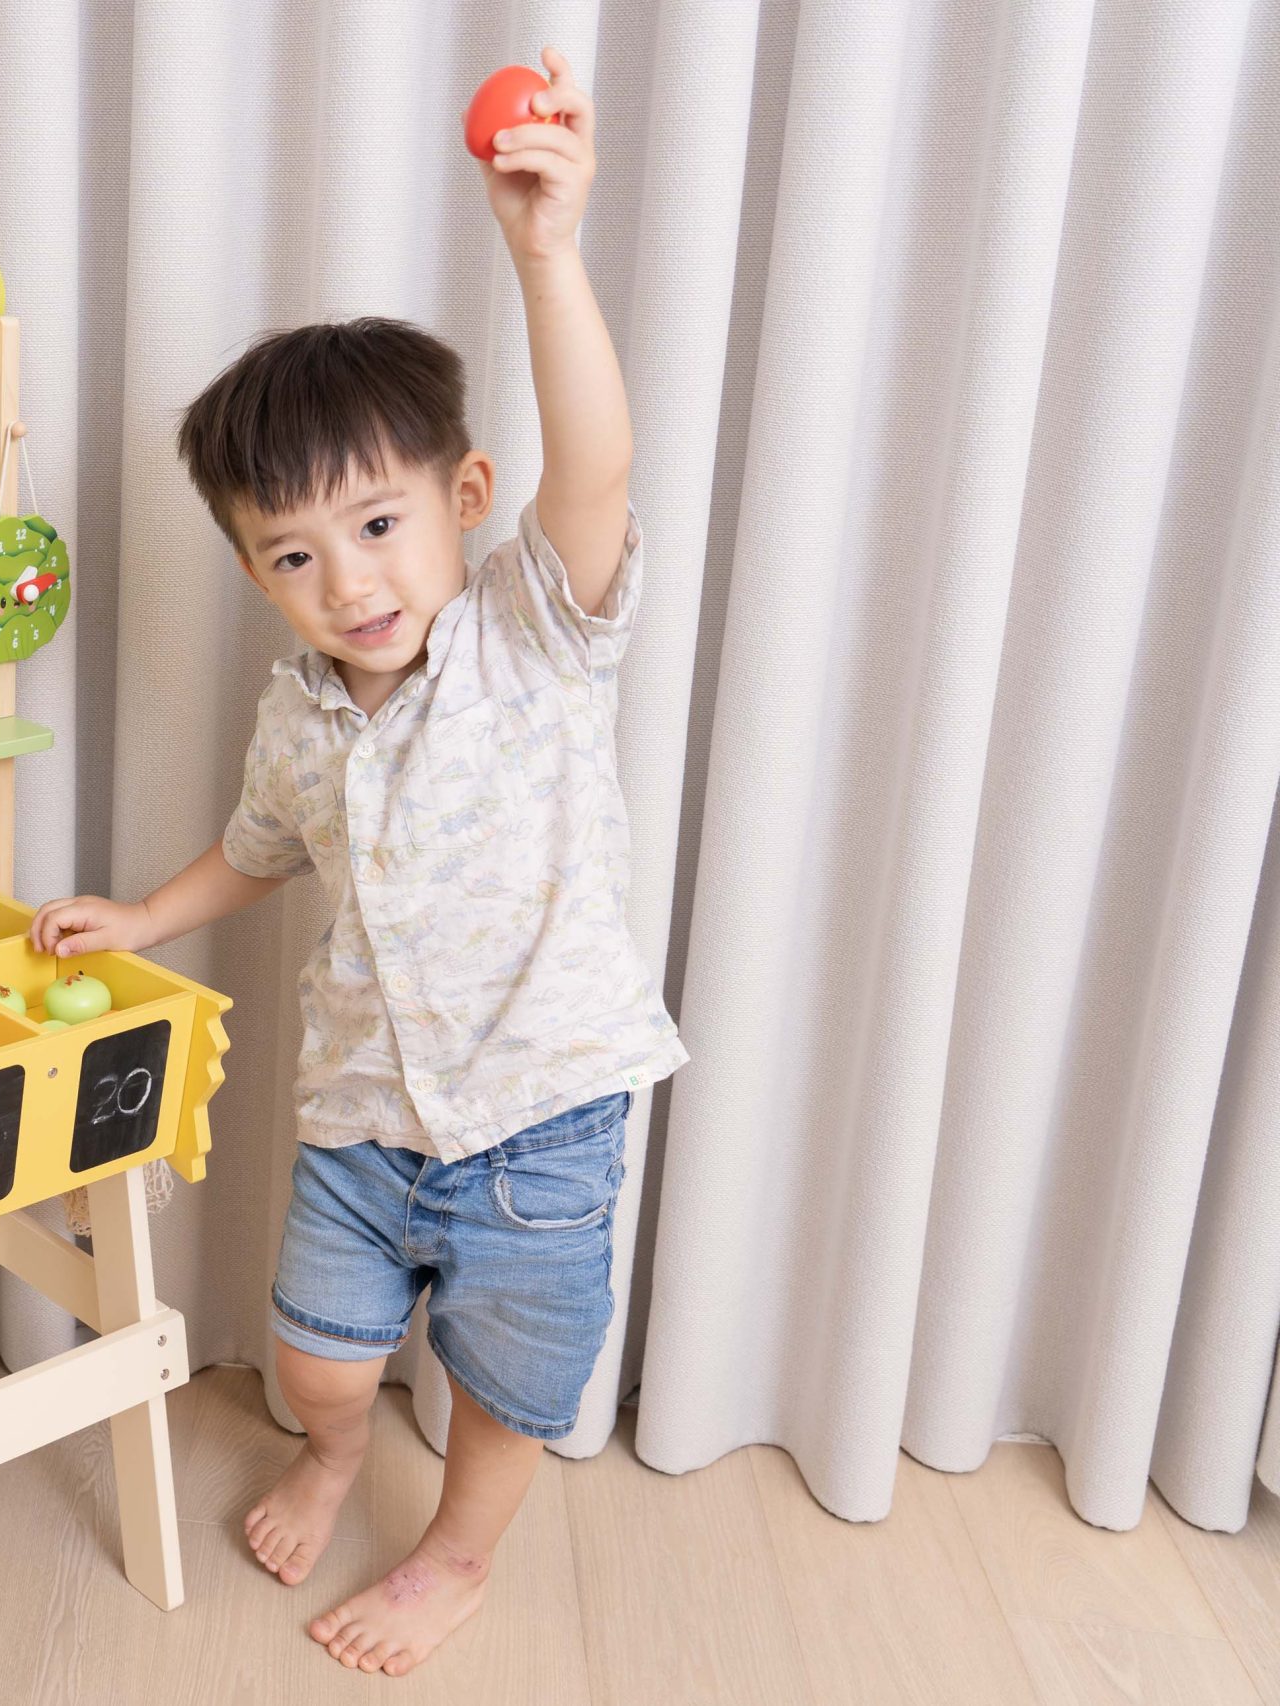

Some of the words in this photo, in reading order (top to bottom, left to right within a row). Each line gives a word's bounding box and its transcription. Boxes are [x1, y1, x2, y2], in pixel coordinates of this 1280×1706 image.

[16, 529, 27, 540] 12
[51, 556, 57, 567] 2
[49, 605, 56, 616] 4
[33, 629, 39, 640] 5
[12, 637, 18, 648] 6
[91, 1067, 153, 1125] 20
